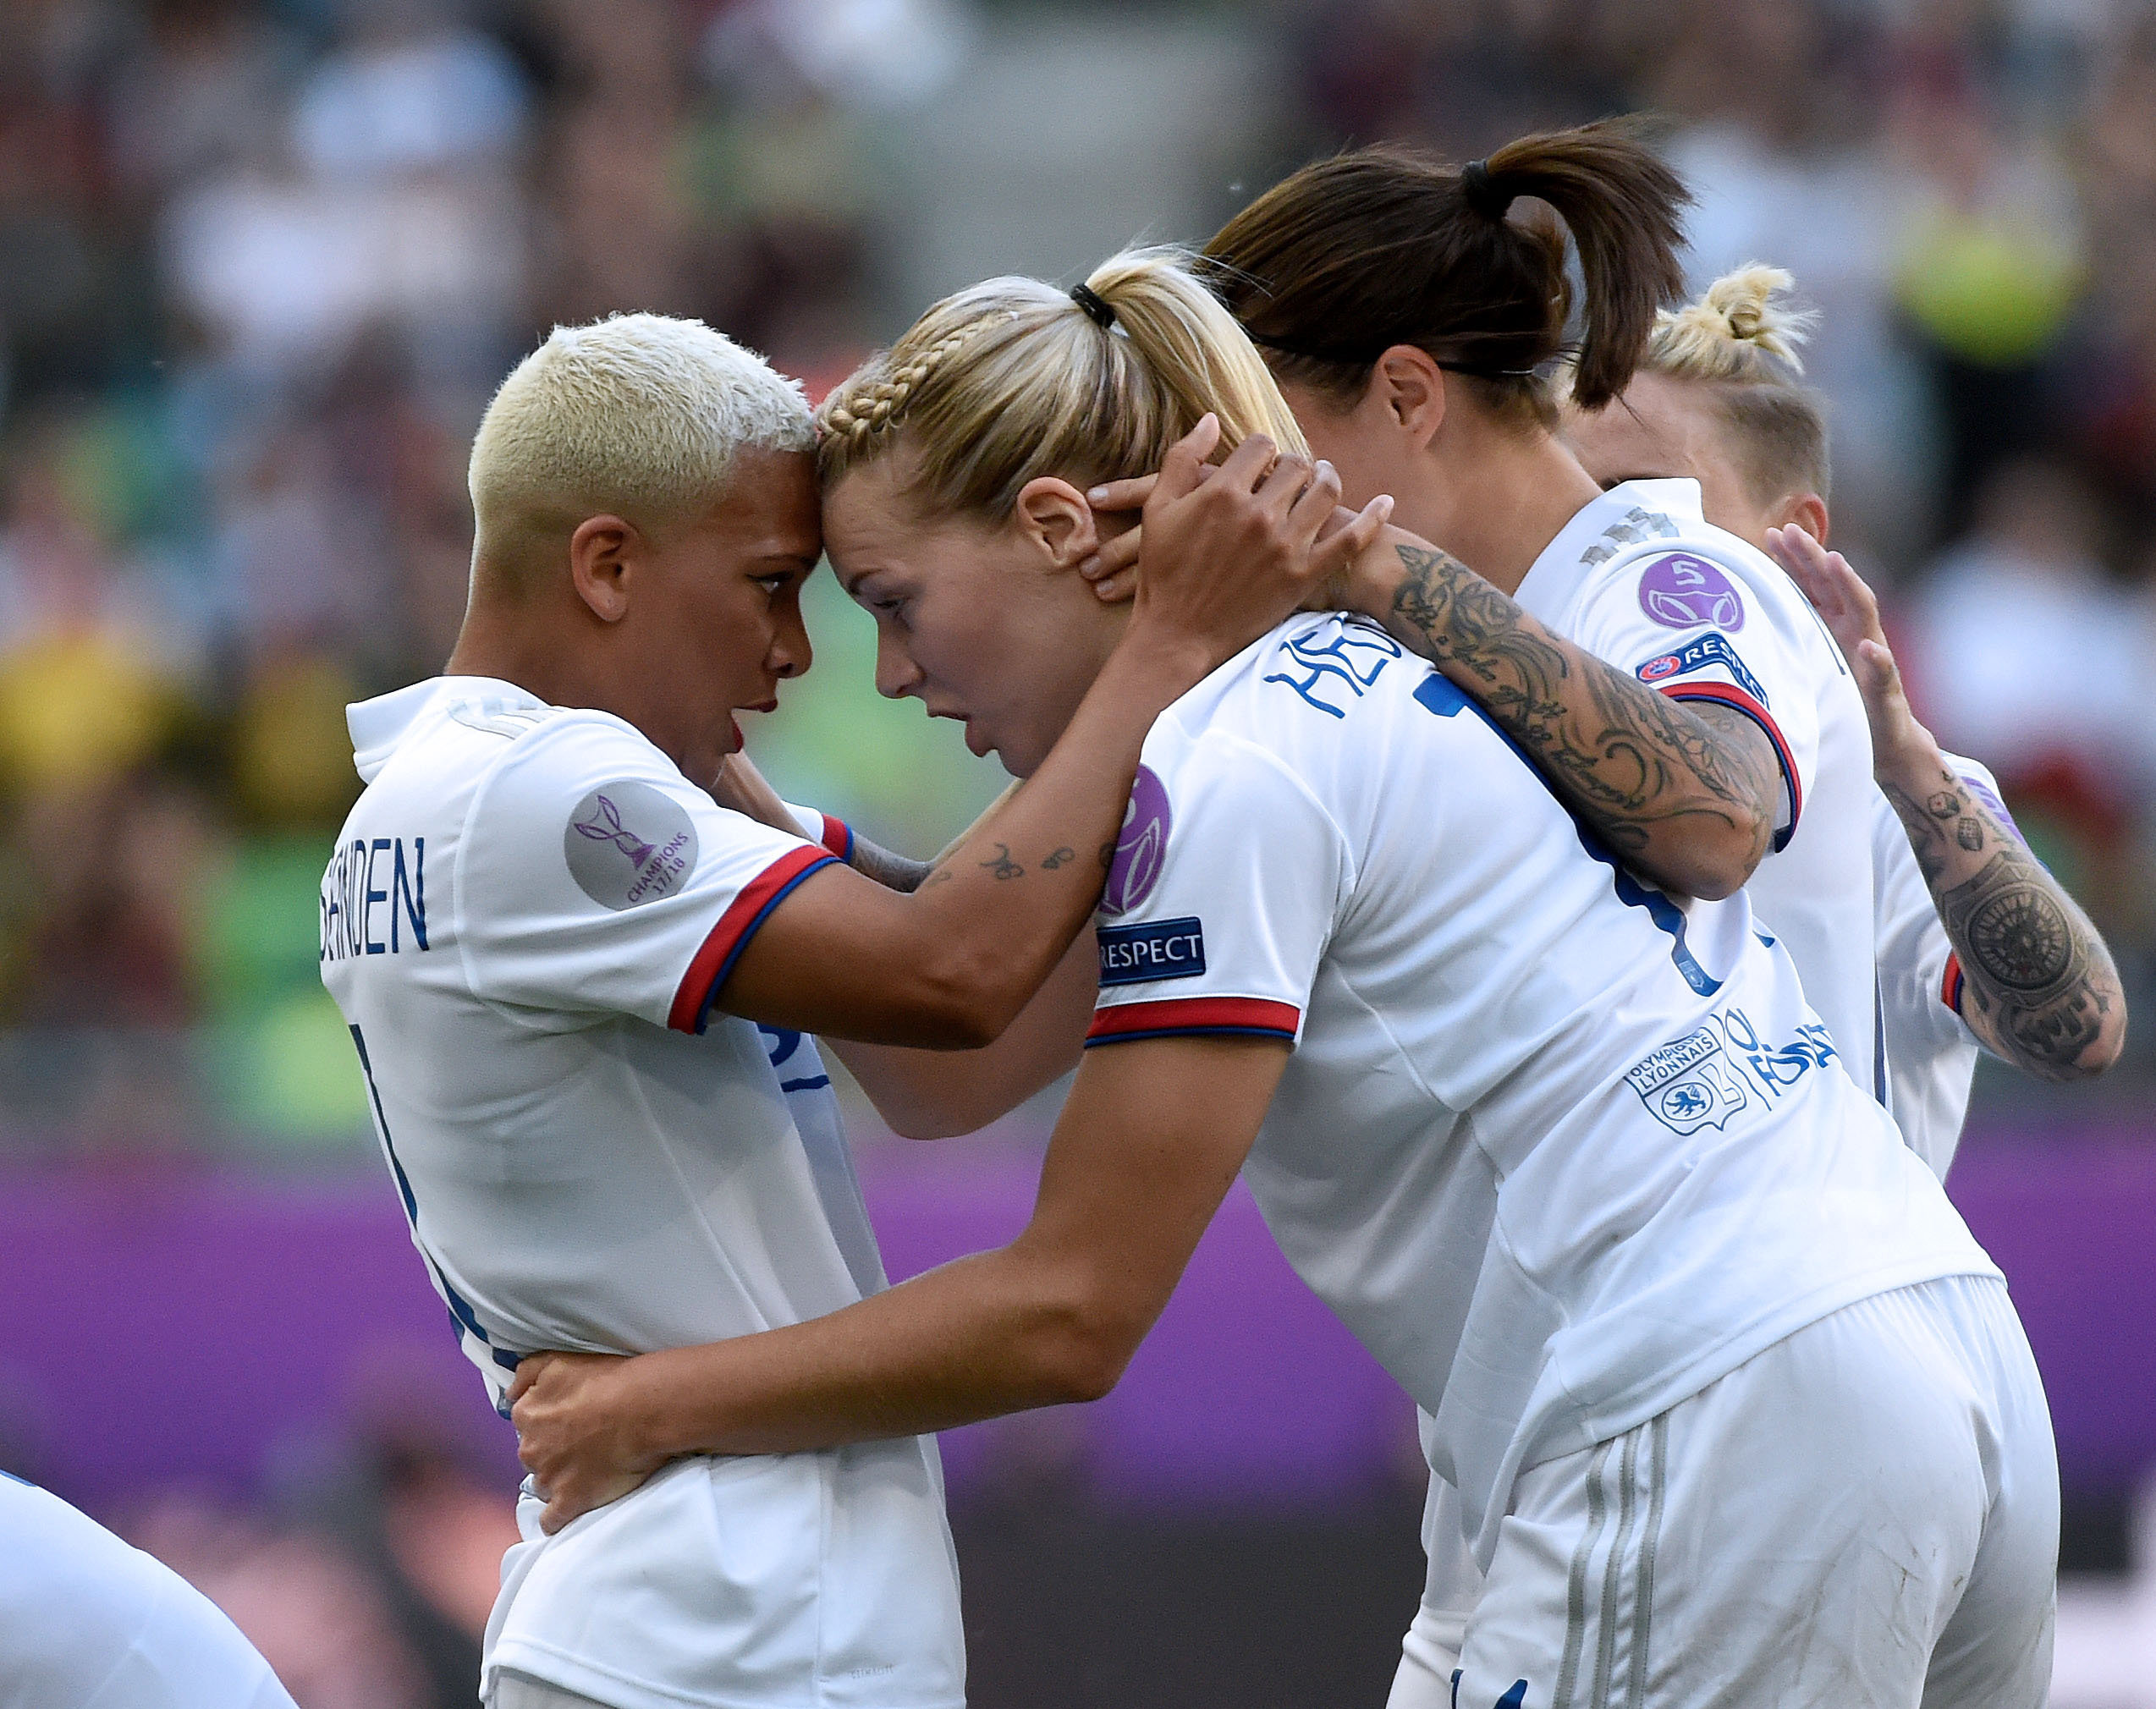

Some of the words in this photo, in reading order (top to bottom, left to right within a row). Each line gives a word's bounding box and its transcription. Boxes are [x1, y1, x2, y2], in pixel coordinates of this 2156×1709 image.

[1671, 560, 1706, 585] 5
[627, 832, 689, 902] CHAMPIONS
[652, 857, 685, 894] 17/18
[1638, 1036, 1713, 1090] LYONNAIS
